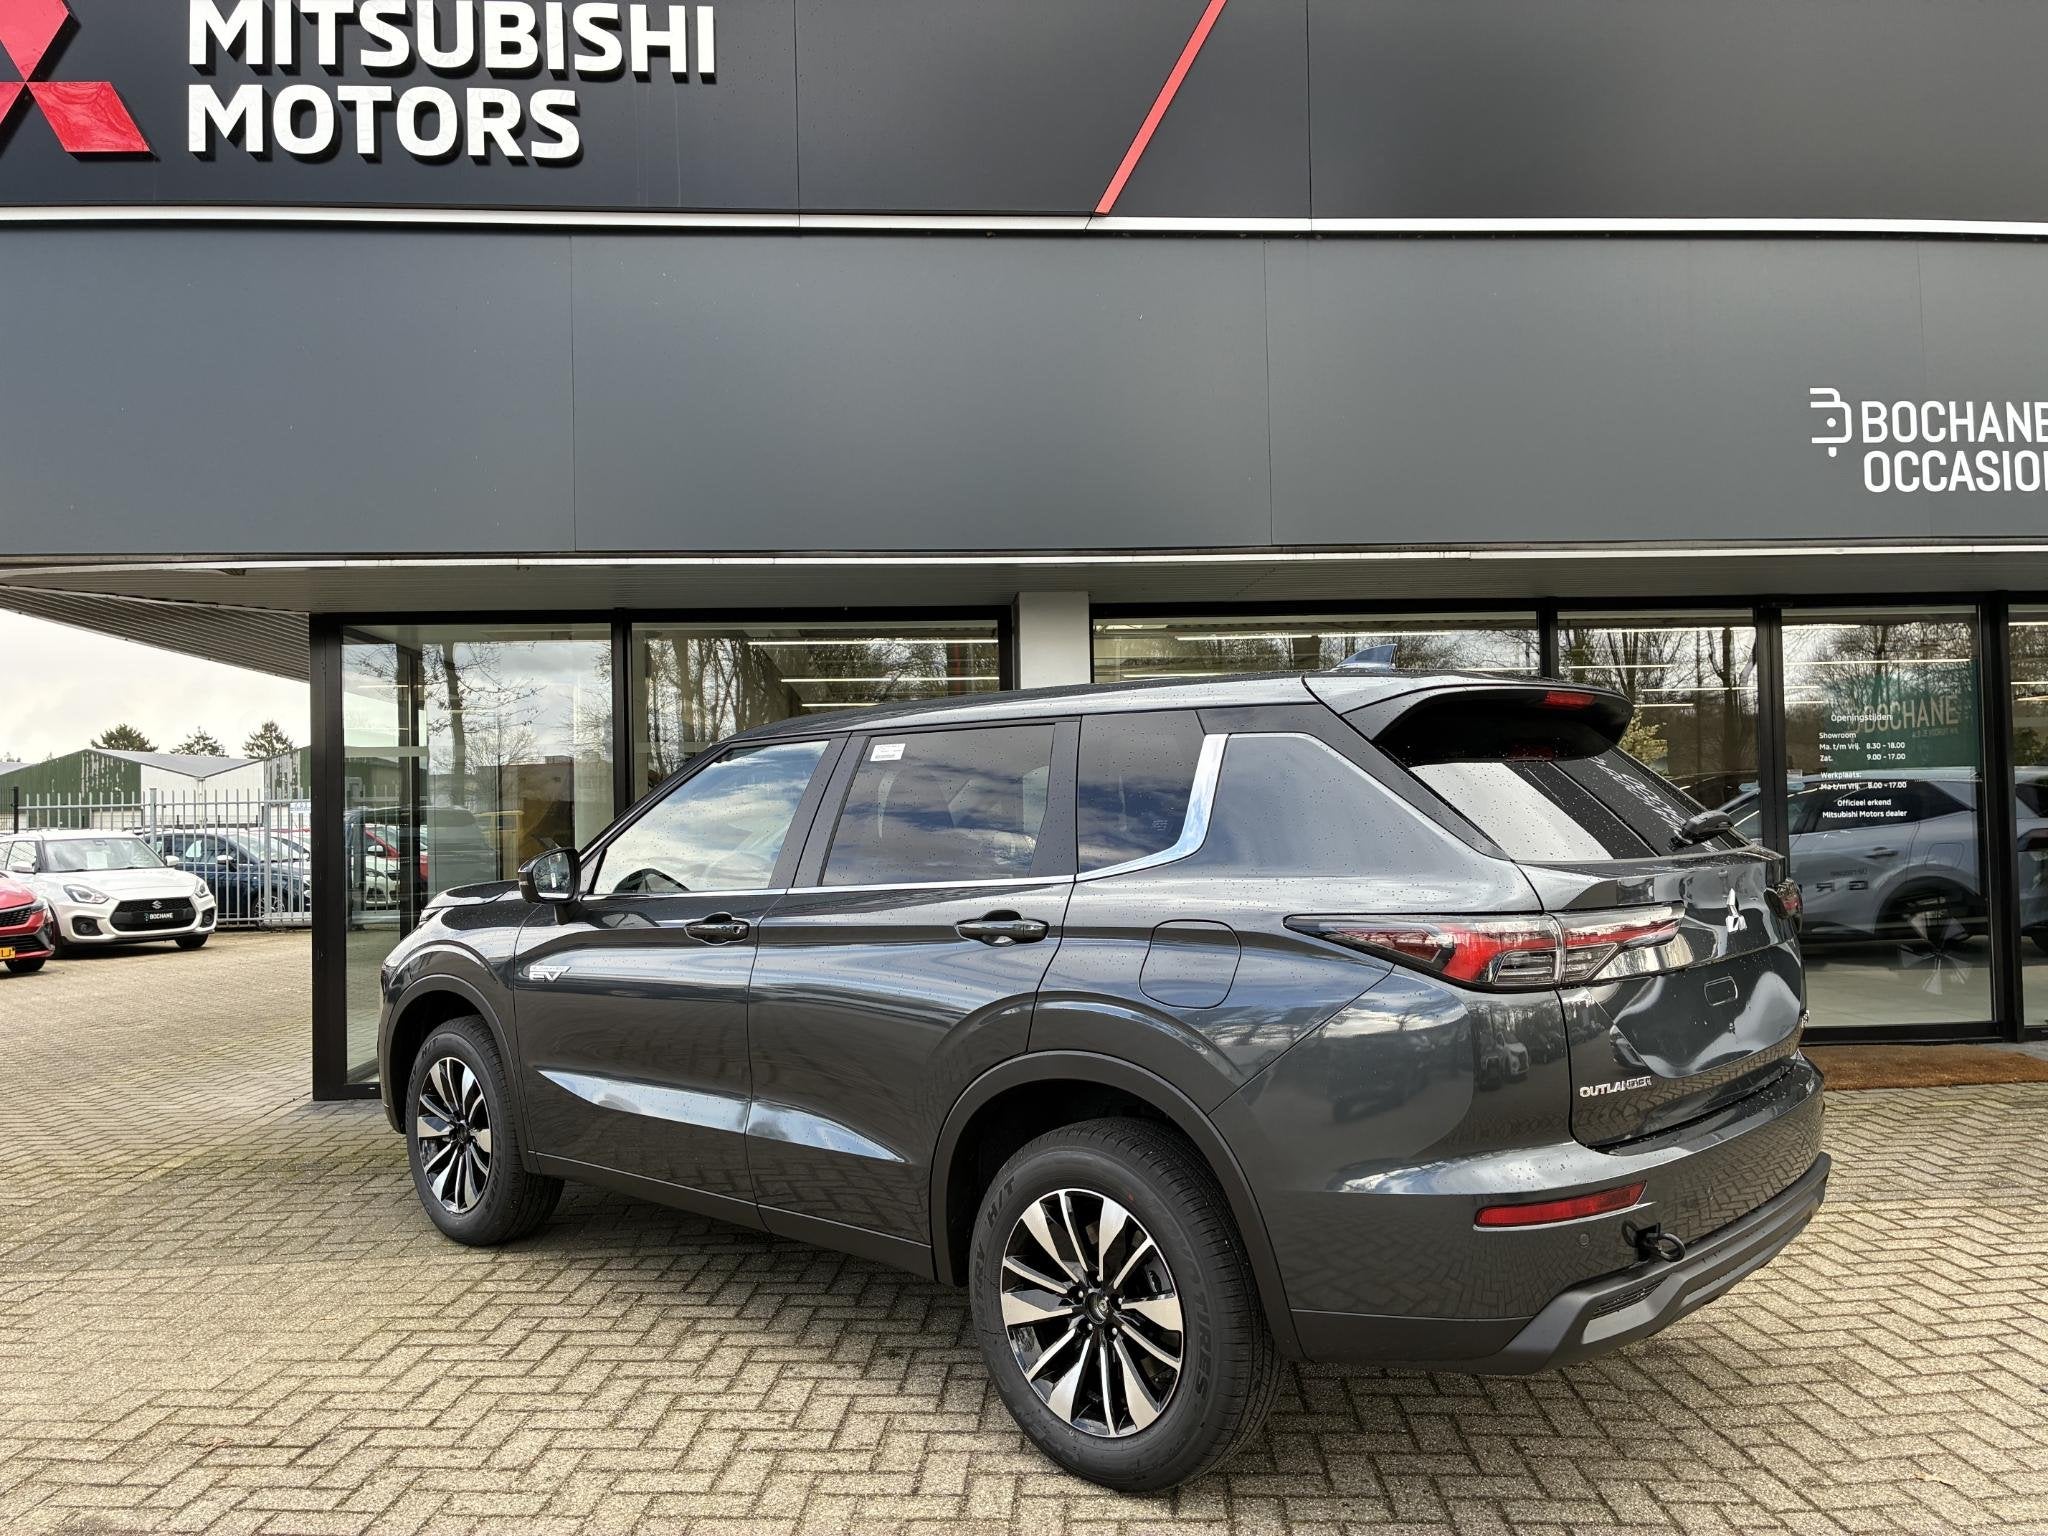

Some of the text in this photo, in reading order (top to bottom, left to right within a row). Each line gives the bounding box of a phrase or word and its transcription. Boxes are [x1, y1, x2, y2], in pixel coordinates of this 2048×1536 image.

[189, 0, 715, 73] MITSUBISHI
[188, 84, 580, 159] MOTORS
[1861, 400, 2048, 443] BOCHANE
[1863, 450, 2048, 492] OCCASIO
[1831, 712, 1893, 723] Openingstijden
[1887, 741, 1905, 749] 18.00
[1820, 754, 1833, 762] Zat.
[1837, 798, 1892, 807] Officieel erkend
[1859, 810, 1884, 818] Motors
[1885, 809, 1908, 817] dealer
[1579, 1075, 1652, 1098] OUTLANDER
